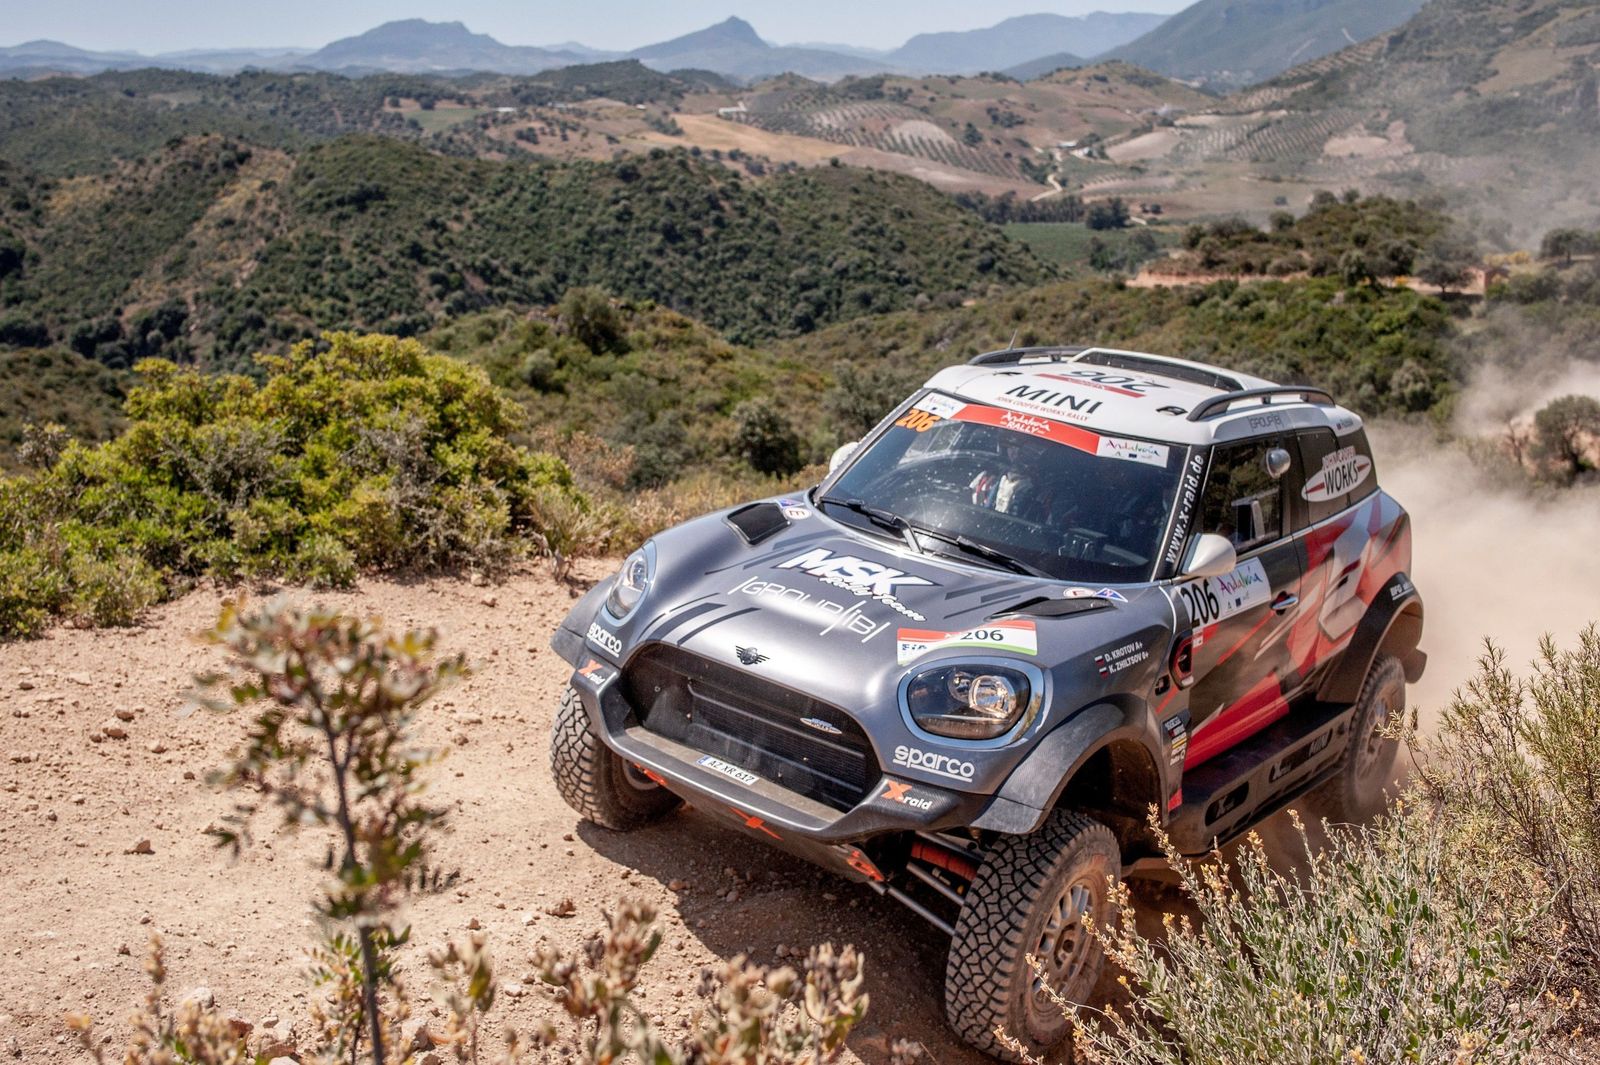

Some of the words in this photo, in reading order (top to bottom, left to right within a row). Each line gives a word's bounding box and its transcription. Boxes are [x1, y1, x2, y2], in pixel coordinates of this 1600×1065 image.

[1005, 385, 1104, 414] MINI
[895, 408, 941, 432] 206
[1324, 460, 1358, 495] WORKS
[1165, 454, 1204, 564] www.x-raid.de
[773, 548, 937, 597] MSK
[1180, 578, 1220, 629] 206
[587, 622, 622, 658] sparco
[960, 629, 1004, 642] 206
[1111, 642, 1135, 660] KROTOV
[735, 769, 755, 783] 617
[893, 745, 975, 783] sparco
